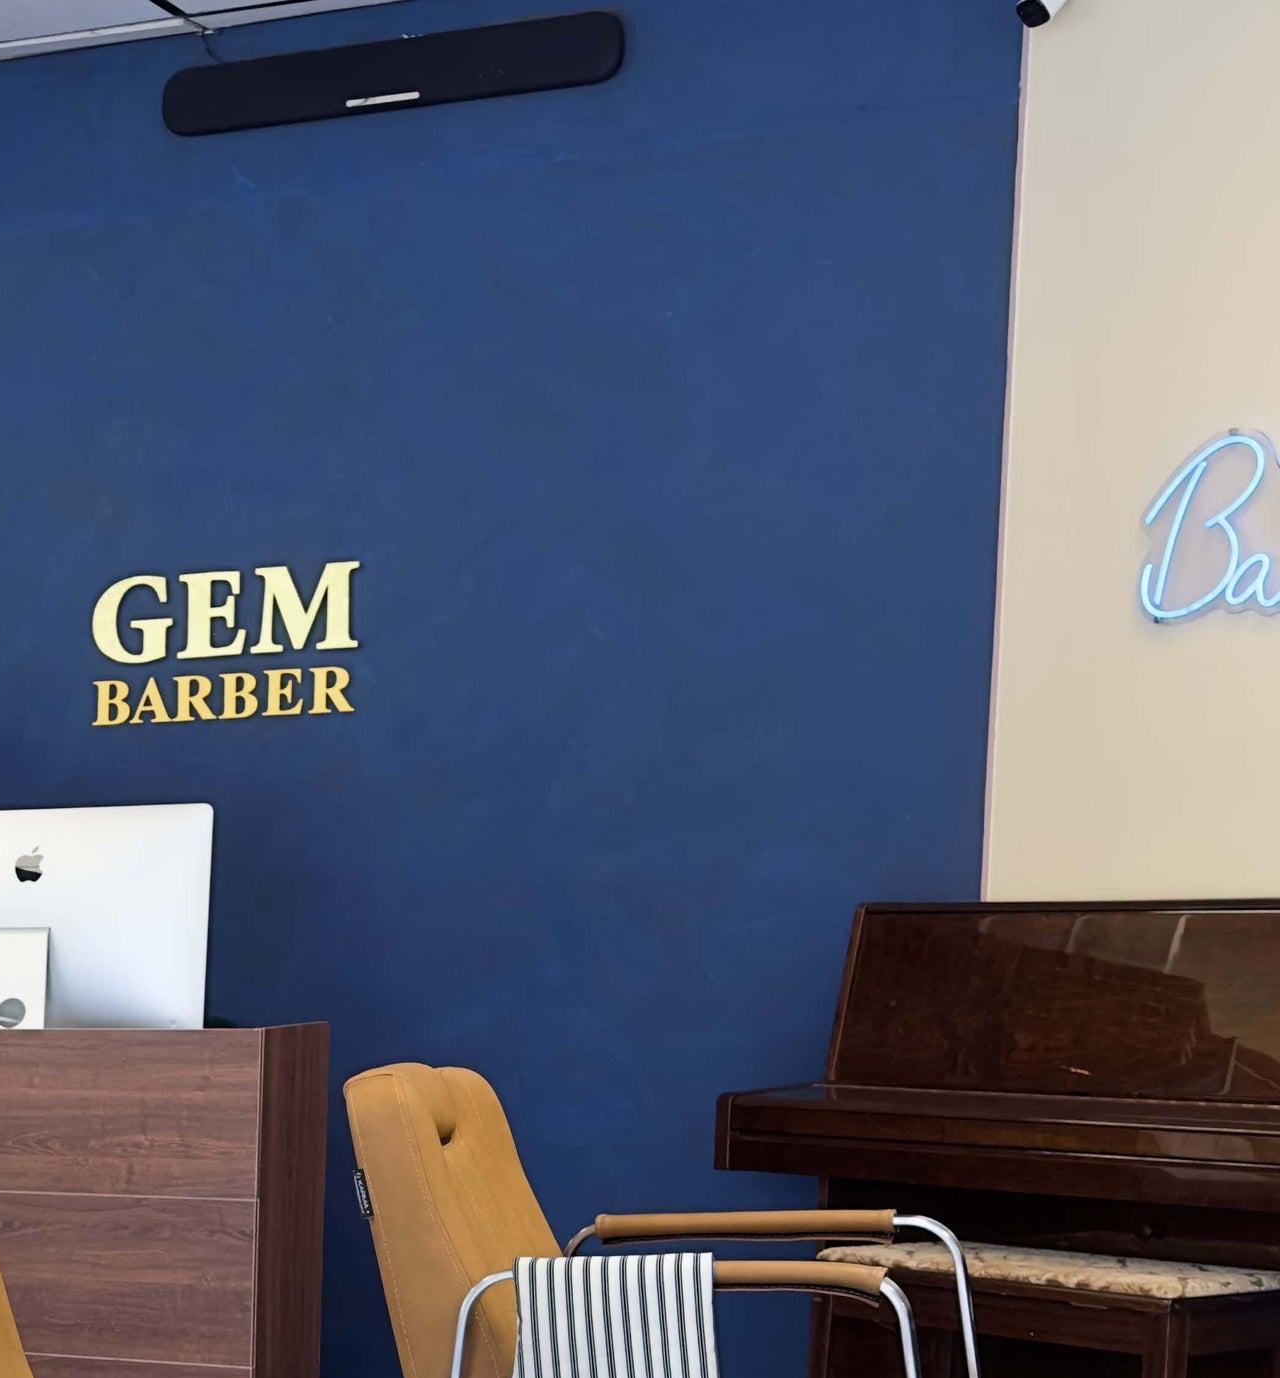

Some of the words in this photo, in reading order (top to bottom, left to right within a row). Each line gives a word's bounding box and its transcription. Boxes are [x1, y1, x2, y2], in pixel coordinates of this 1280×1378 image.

[1140, 434, 1280, 620] Ba
[92, 560, 360, 664] GEM
[91, 666, 355, 727] BARBER
